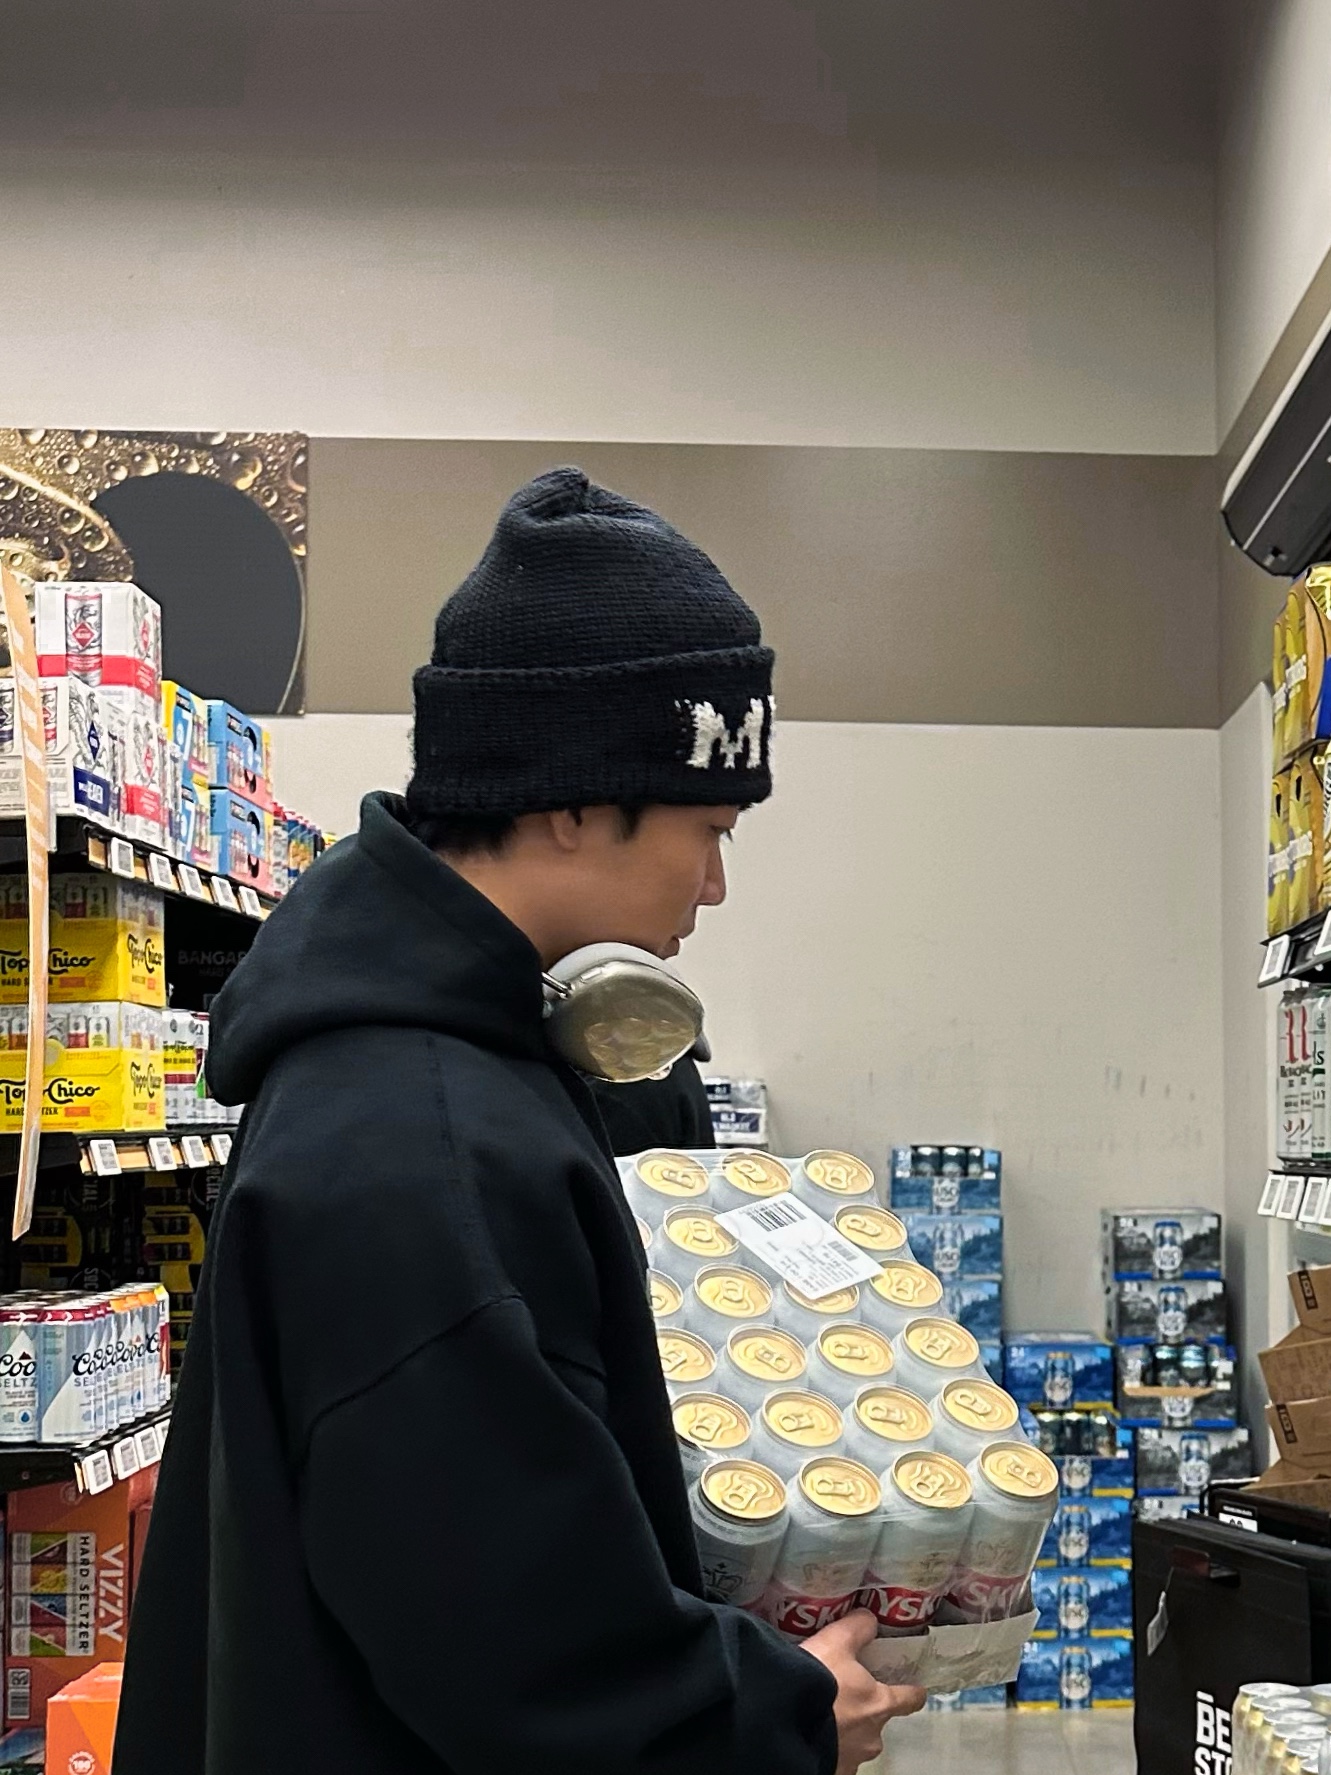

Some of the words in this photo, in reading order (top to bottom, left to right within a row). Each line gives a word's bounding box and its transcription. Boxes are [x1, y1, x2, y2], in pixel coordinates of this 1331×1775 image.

[686, 695, 776, 769] M
[0, 950, 29, 975] Top
[48, 1078, 101, 1104] Chico
[0, 1353, 37, 1377] Coo
[0, 1377, 37, 1388] SELTZ
[78, 1535, 91, 1579] HARD
[99, 1542, 125, 1643] VIZZY
[78, 1582, 91, 1652] SELTZER
[1196, 1700, 1231, 1753] BE
